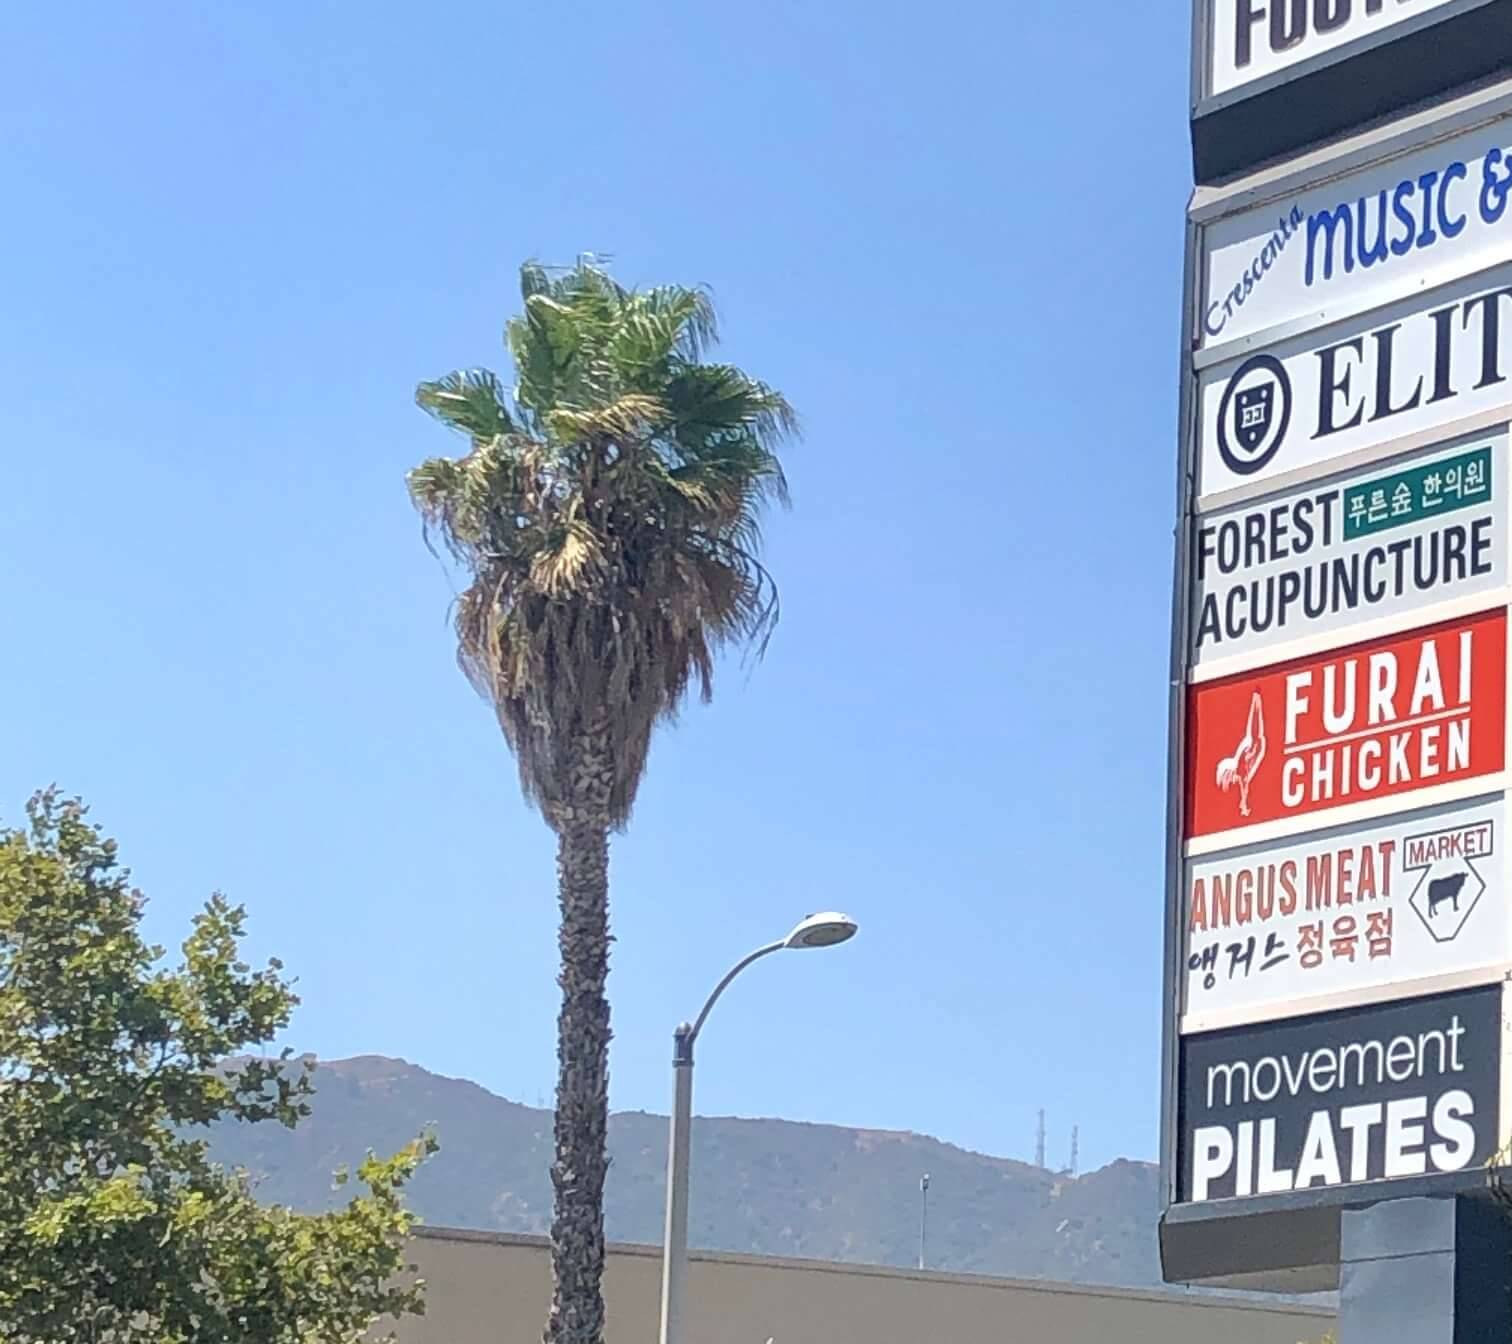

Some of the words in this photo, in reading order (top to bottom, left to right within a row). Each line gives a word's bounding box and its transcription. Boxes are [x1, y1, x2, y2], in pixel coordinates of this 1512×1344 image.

[1204, 204, 1304, 336] Crescenta
[1198, 490, 1339, 581] FOREST
[1348, 481, 1412, 529] 푸른숲
[1421, 459, 1486, 508] 한의원
[1196, 517, 1492, 649] ACUPUNCTURE
[1284, 630, 1473, 744] FURAI
[1281, 718, 1471, 808] CHICKEN
[1190, 860, 1297, 933] ANGUS
[1305, 840, 1396, 911] MEAT
[1408, 827, 1488, 865] MARKET
[1188, 932, 1290, 990] 앵거스
[1297, 907, 1394, 969] 정육점
[1206, 1015, 1466, 1109] movement
[1191, 1089, 1476, 1202] PILATES
